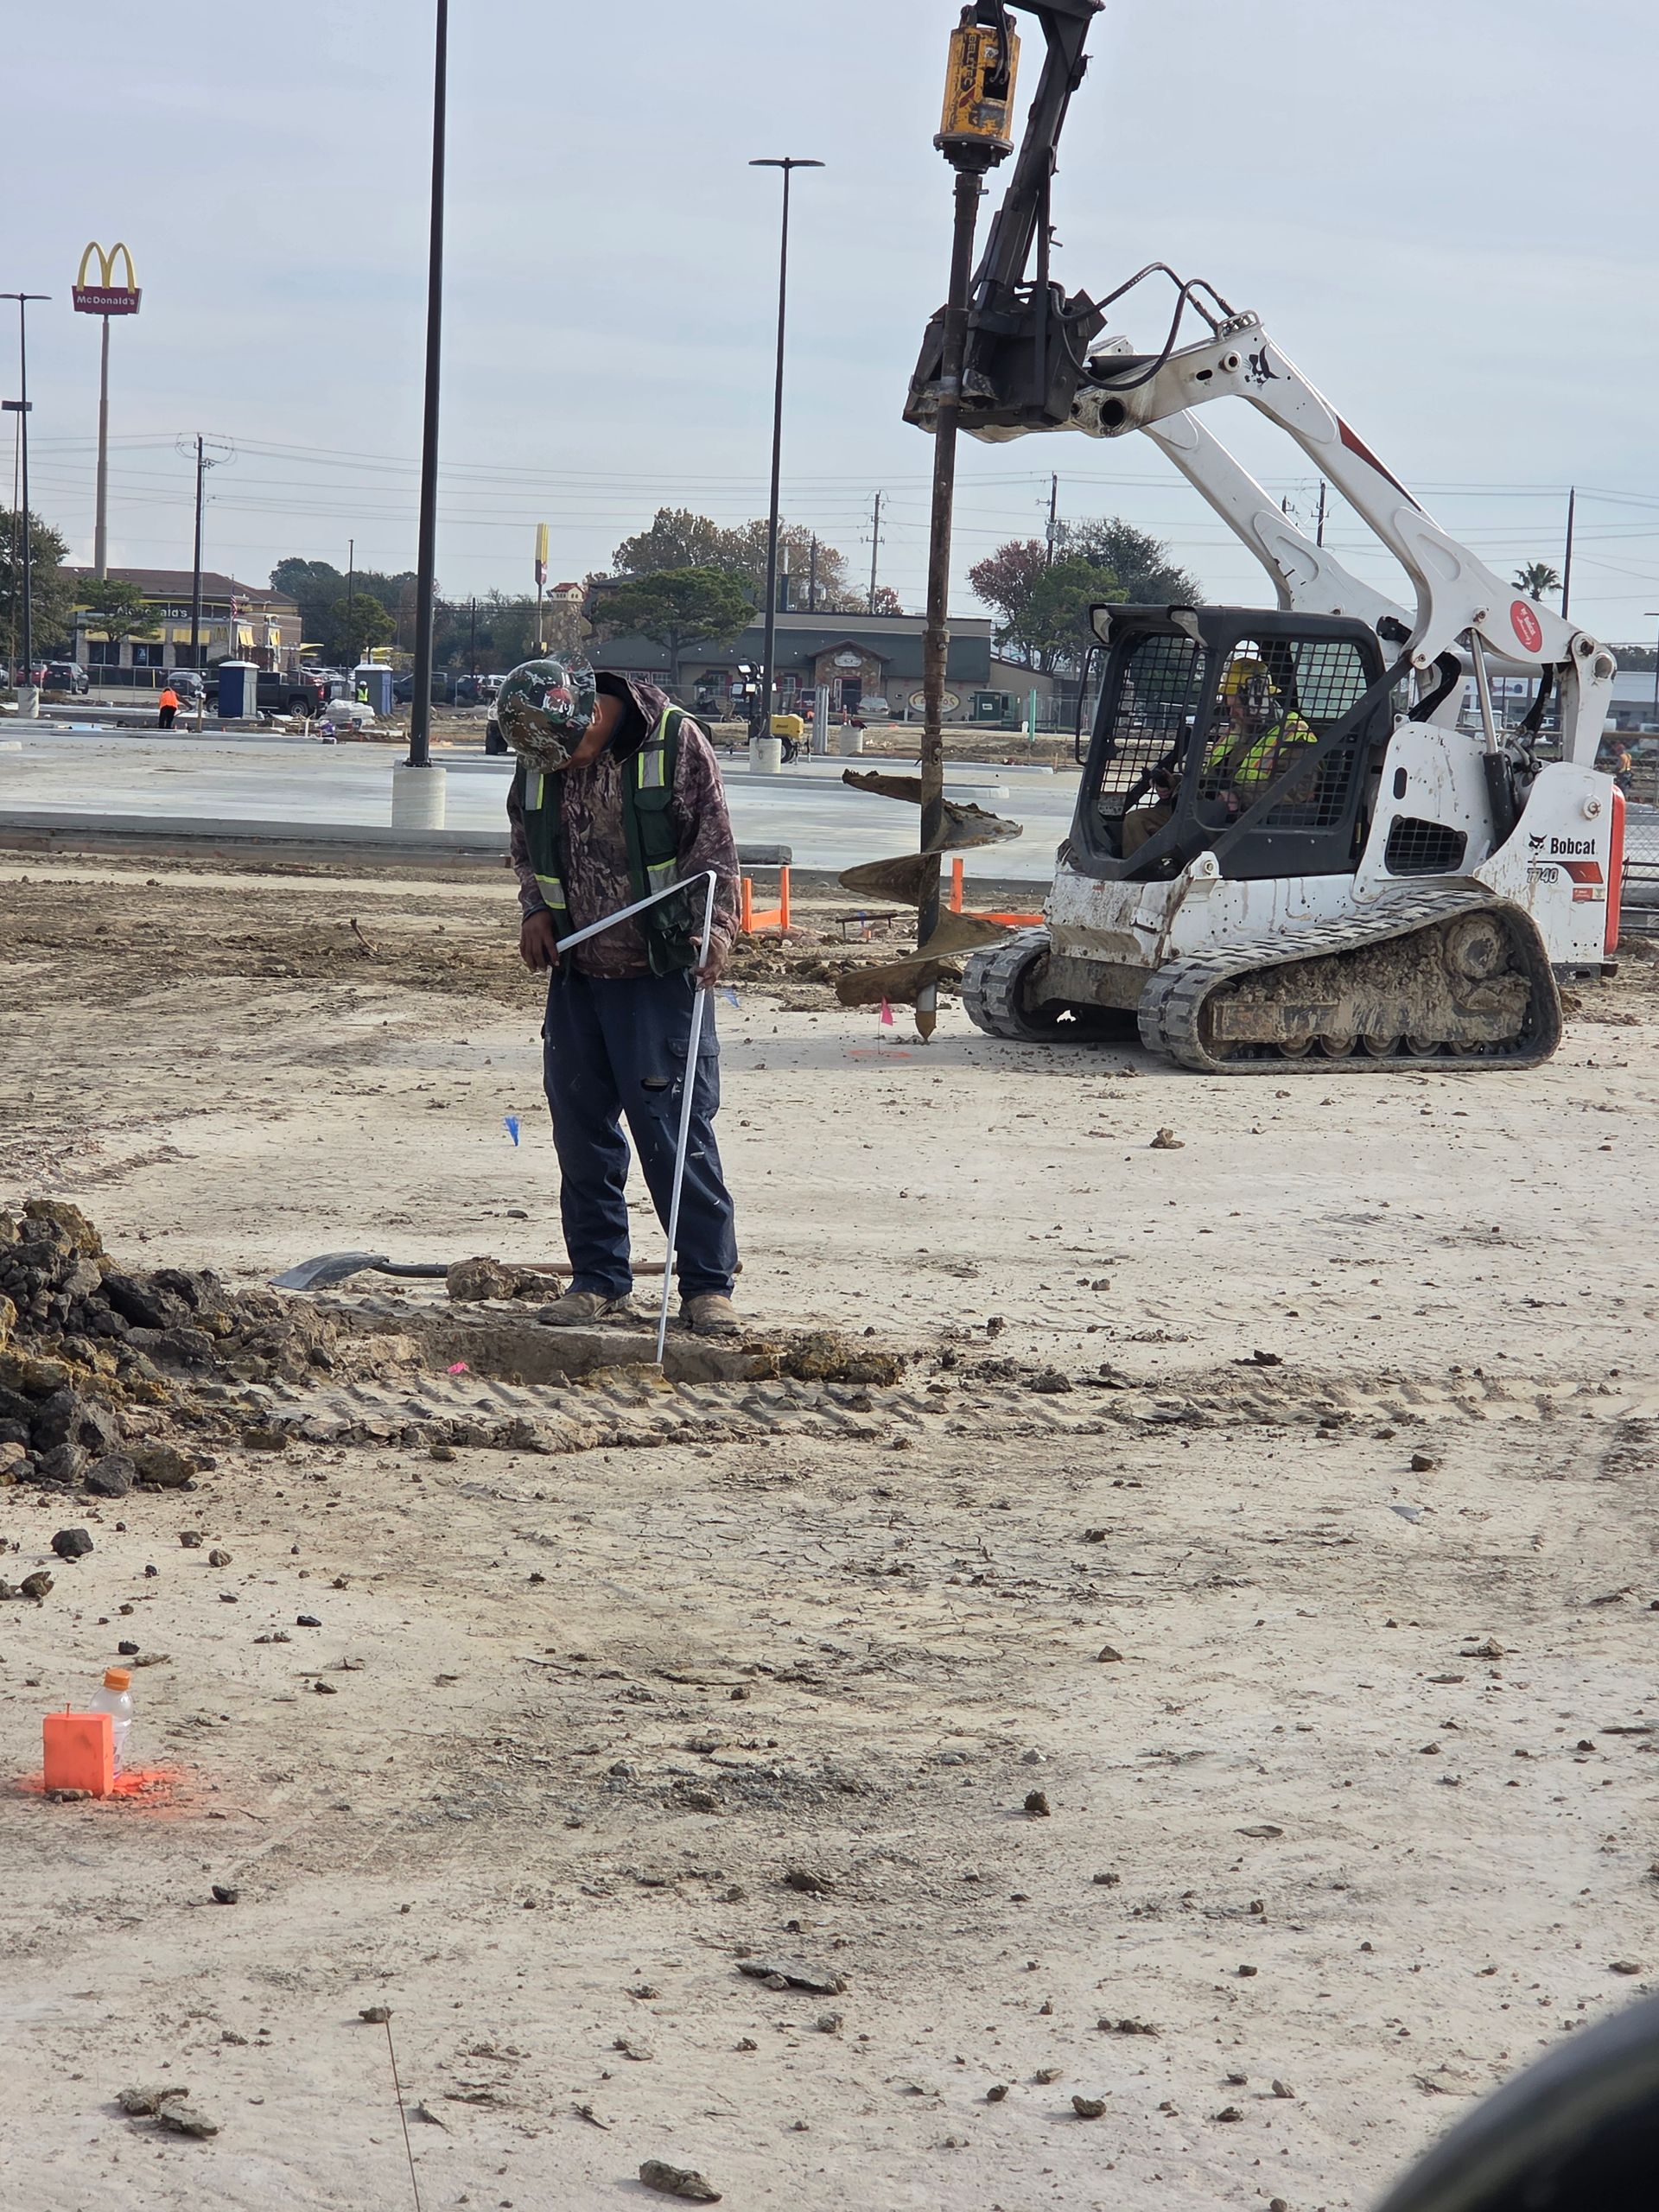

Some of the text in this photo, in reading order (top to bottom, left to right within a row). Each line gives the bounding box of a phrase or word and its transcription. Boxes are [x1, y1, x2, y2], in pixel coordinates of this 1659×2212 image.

[76, 296, 135, 306] McDonald's
[117, 606, 188, 618] Mcoald's
[1550, 837, 1596, 855] Bobcat
[1527, 868, 1560, 883] T740
